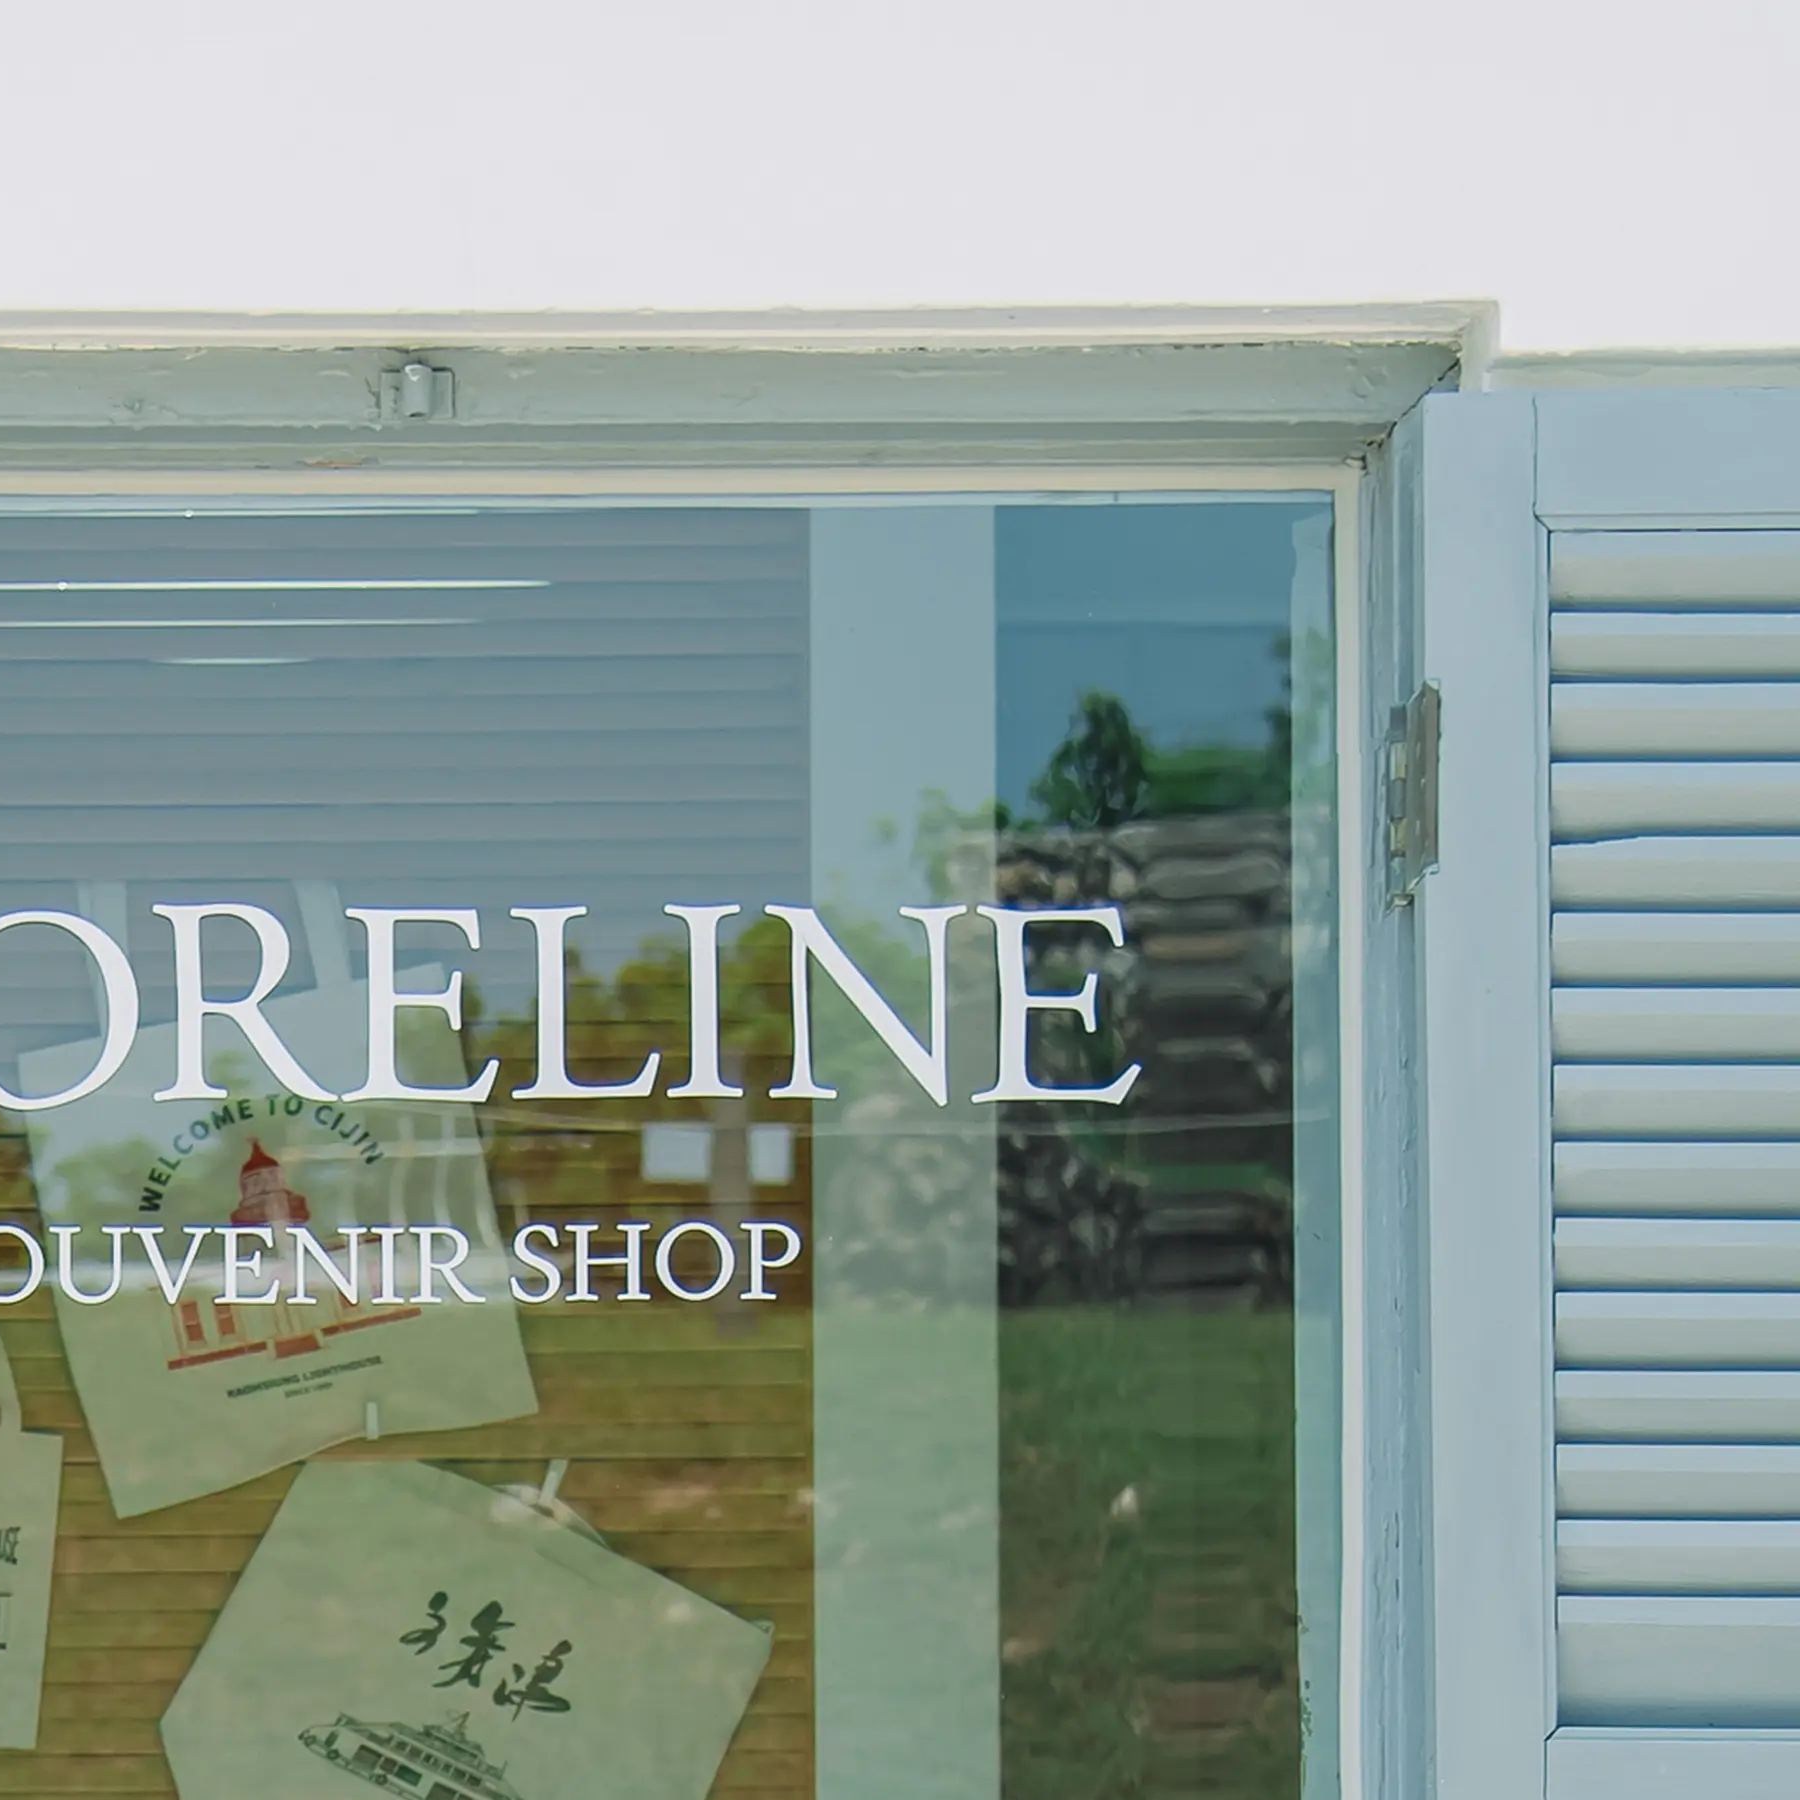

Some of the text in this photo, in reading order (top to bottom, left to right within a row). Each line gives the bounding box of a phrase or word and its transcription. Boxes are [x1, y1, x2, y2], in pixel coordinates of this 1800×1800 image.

[138, 1093, 384, 1212] WELCOME TO CIJIN
[509, 1222, 801, 1303] SHOP
